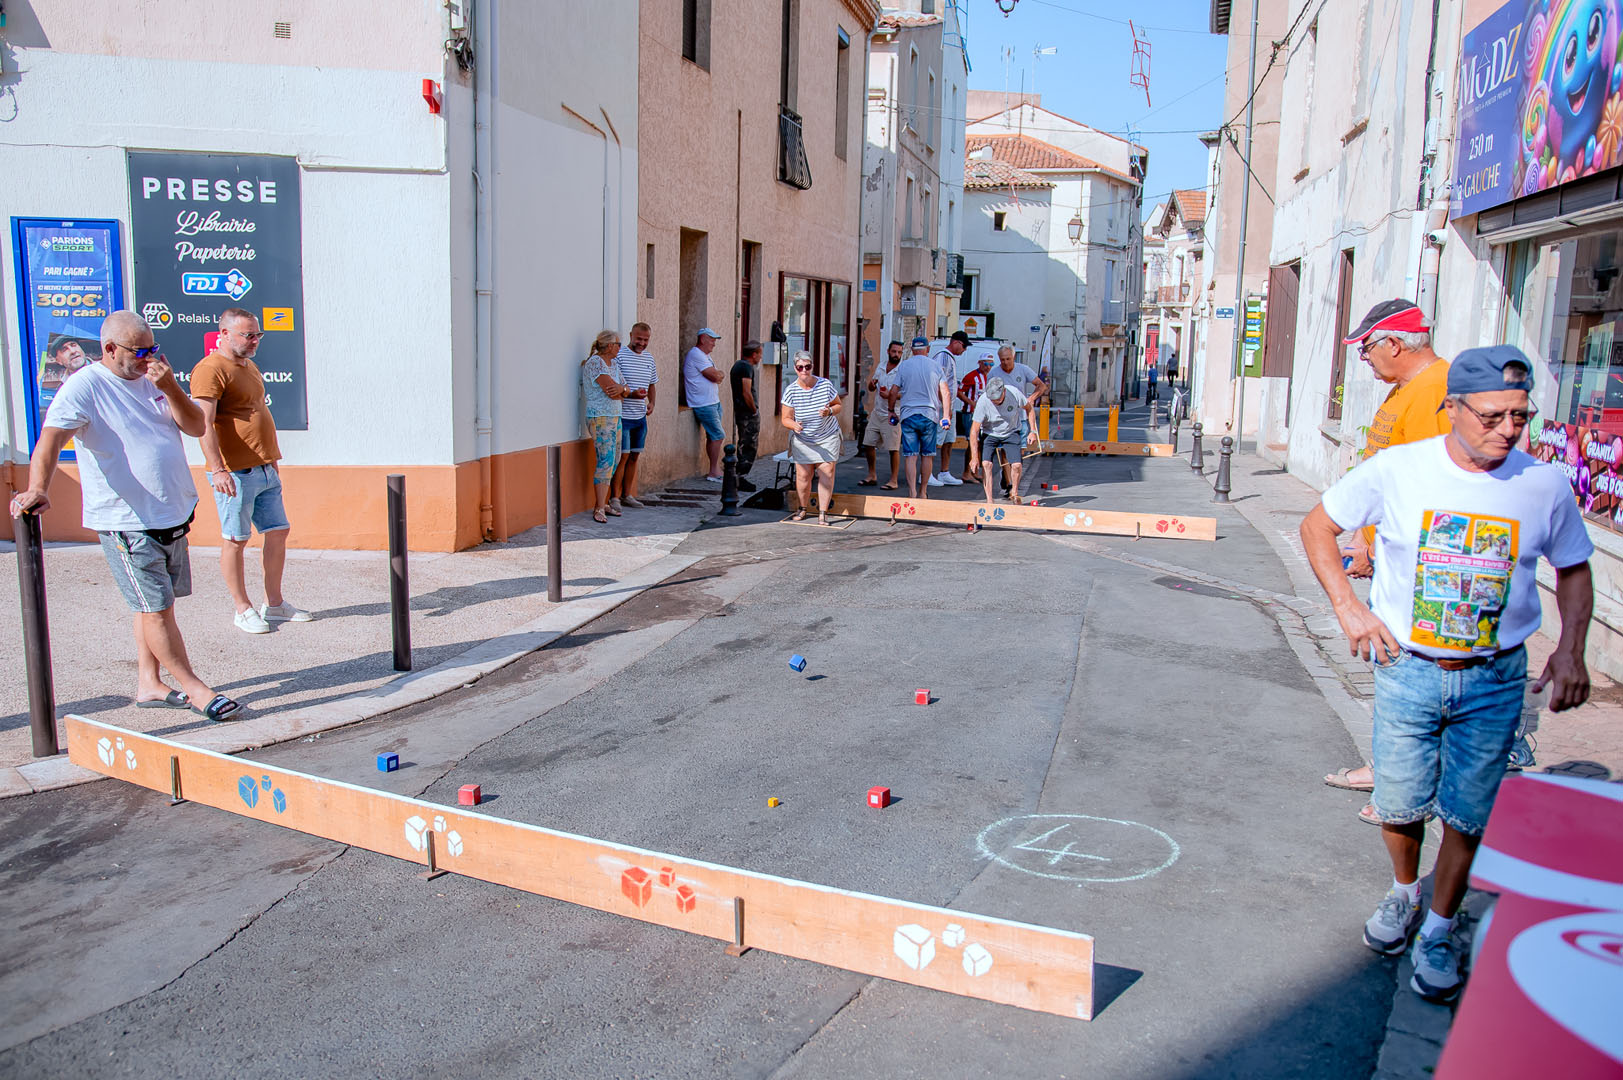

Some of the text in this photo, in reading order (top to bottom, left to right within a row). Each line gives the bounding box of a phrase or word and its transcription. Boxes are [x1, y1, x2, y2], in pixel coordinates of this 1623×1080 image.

[1468, 133, 1494, 160] 250 m
[142, 177, 277, 203] PRESSE
[1464, 162, 1501, 198] GAUCHE
[174, 210, 256, 236] Librairie
[51, 236, 94, 245] PARIONS
[174, 241, 256, 264] Papeterie
[43, 266, 95, 277] PARI GAGNÉ ?
[186, 277, 219, 291] FDJ
[52, 308, 107, 317] en cash
[177, 313, 210, 324] Relais
[1586, 440, 1617, 464] GRANITA
[1596, 473, 1609, 494] JUS
[1012, 823, 1111, 865] 4
